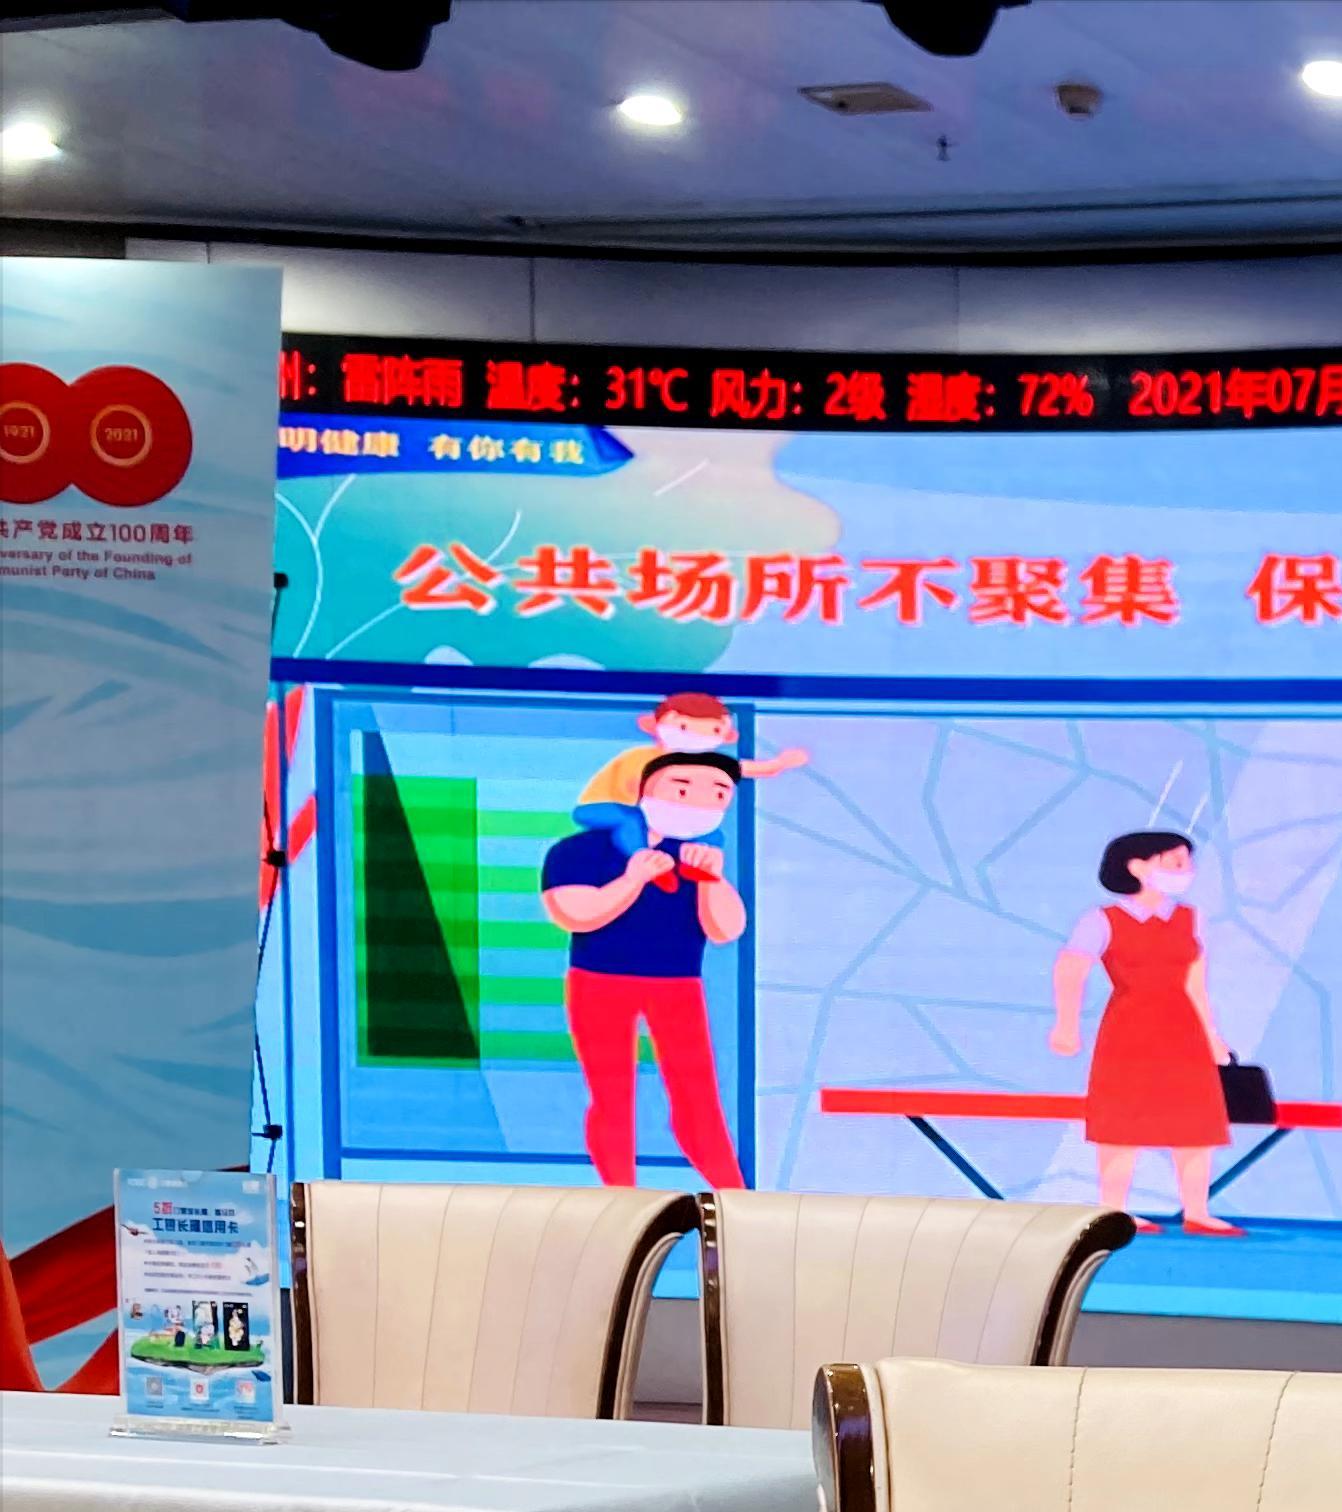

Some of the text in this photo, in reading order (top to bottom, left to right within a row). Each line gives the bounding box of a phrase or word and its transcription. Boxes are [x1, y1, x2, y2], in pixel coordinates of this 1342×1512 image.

[391, 541, 1183, 625] 公共场所不聚集
